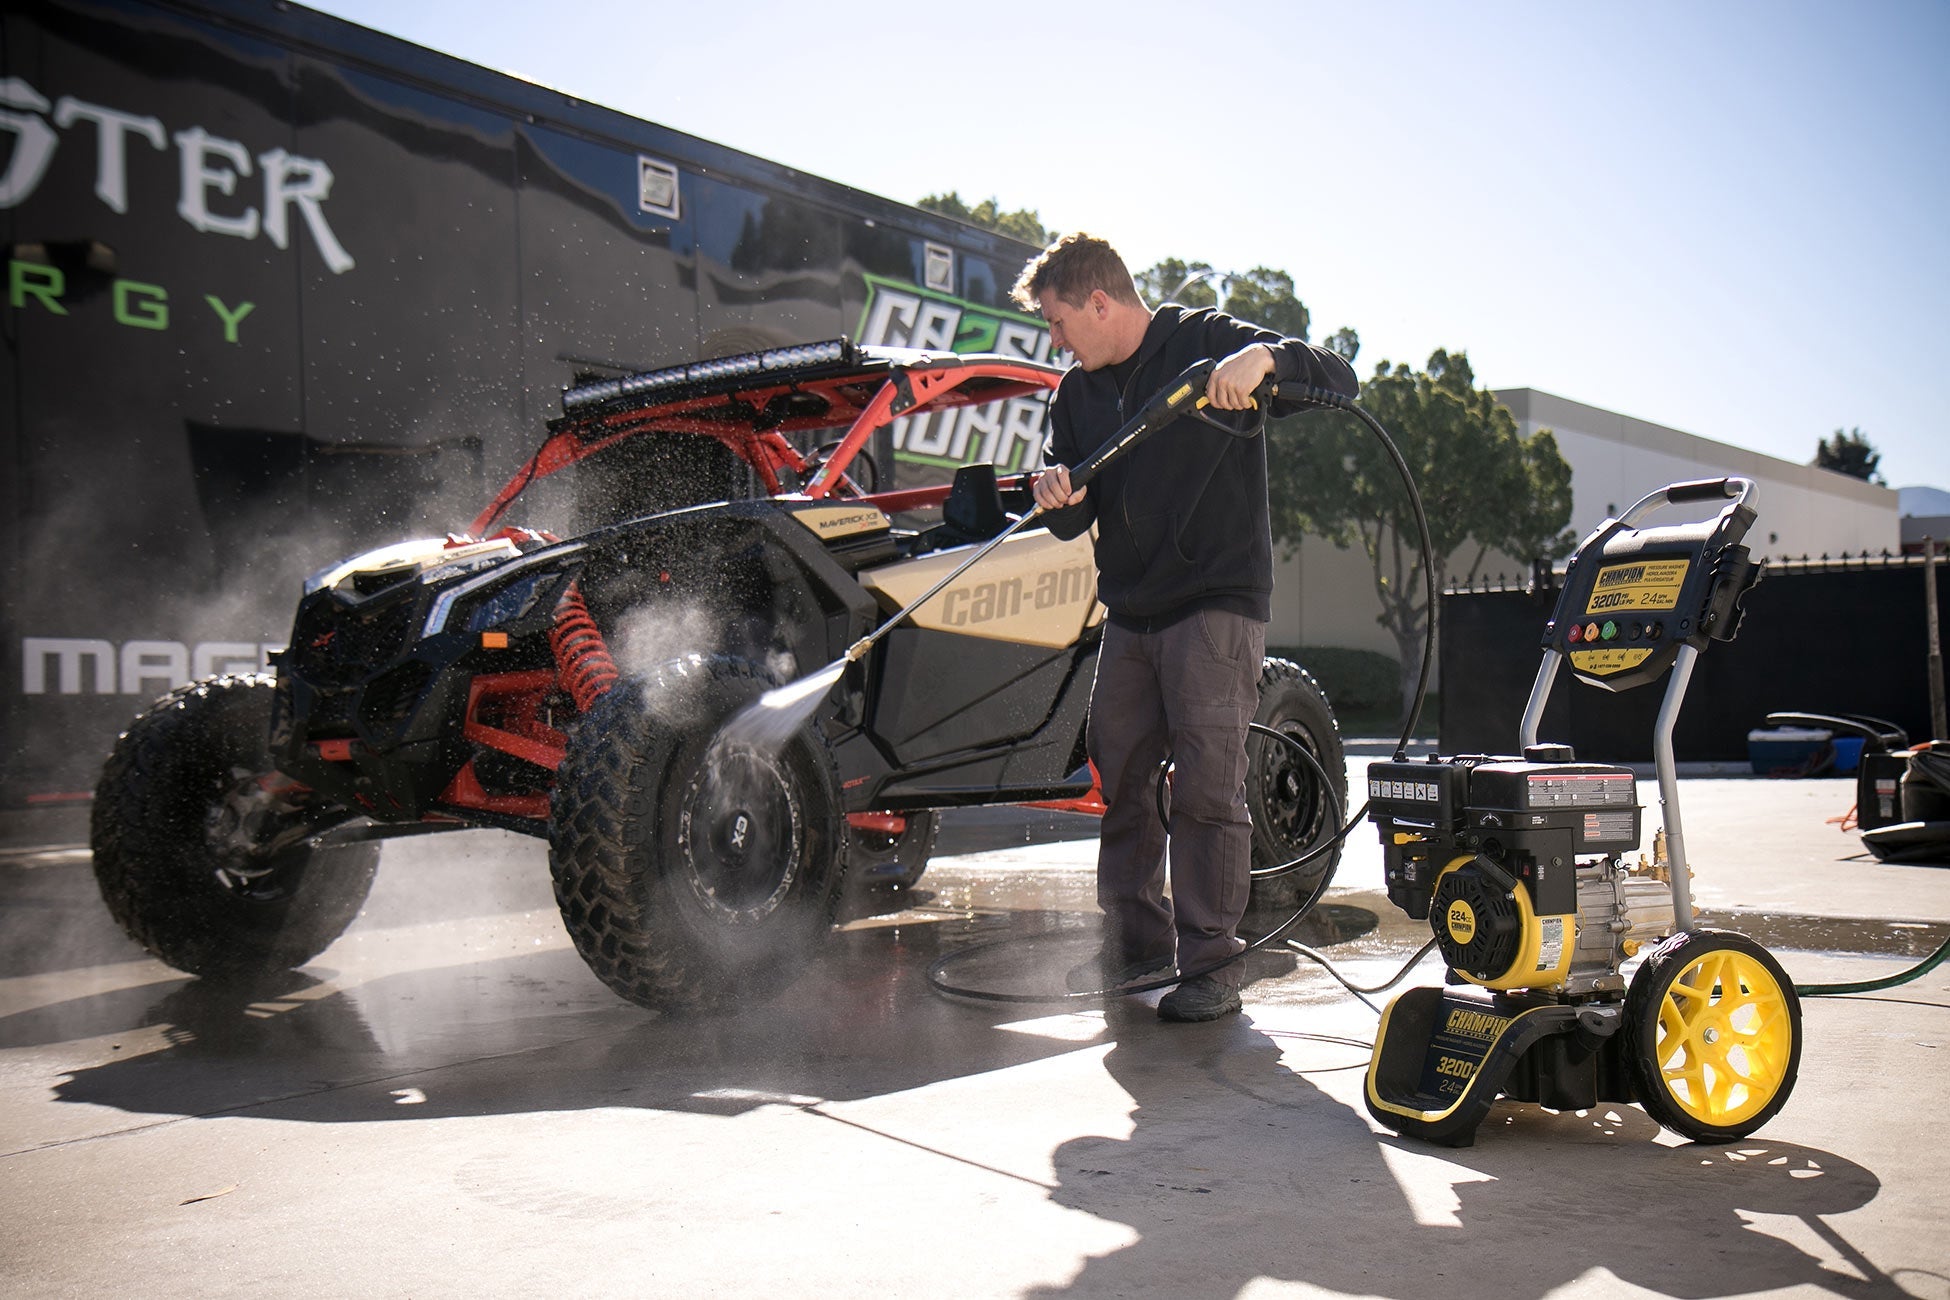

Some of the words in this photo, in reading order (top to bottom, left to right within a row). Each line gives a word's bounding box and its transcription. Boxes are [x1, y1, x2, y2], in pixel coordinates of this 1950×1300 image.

[820, 515, 865, 529] MAVERICK
[1599, 566, 1646, 584] CHAMPION
[1590, 592, 1622, 610] 3200
[1447, 1010, 1512, 1036] CHAMPIO
[1436, 1056, 1473, 1079] 3200
